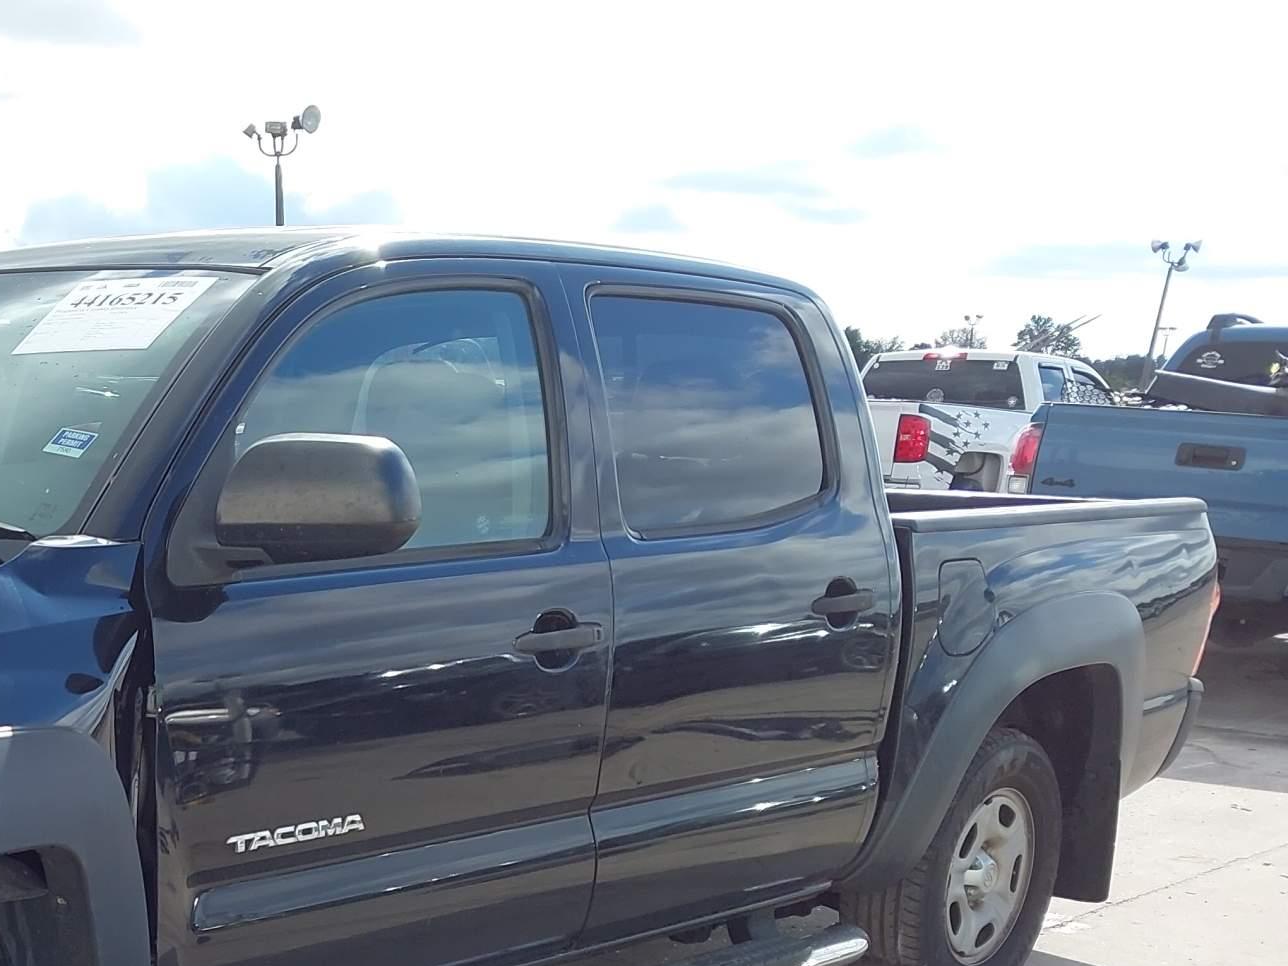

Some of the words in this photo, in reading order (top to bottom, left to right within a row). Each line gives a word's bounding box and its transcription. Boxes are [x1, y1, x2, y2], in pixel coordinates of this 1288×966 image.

[70, 291, 184, 308] 44165215
[62, 431, 90, 441] PARKING
[57, 438, 82, 448] PERMIT
[226, 814, 365, 853] TACOMA
